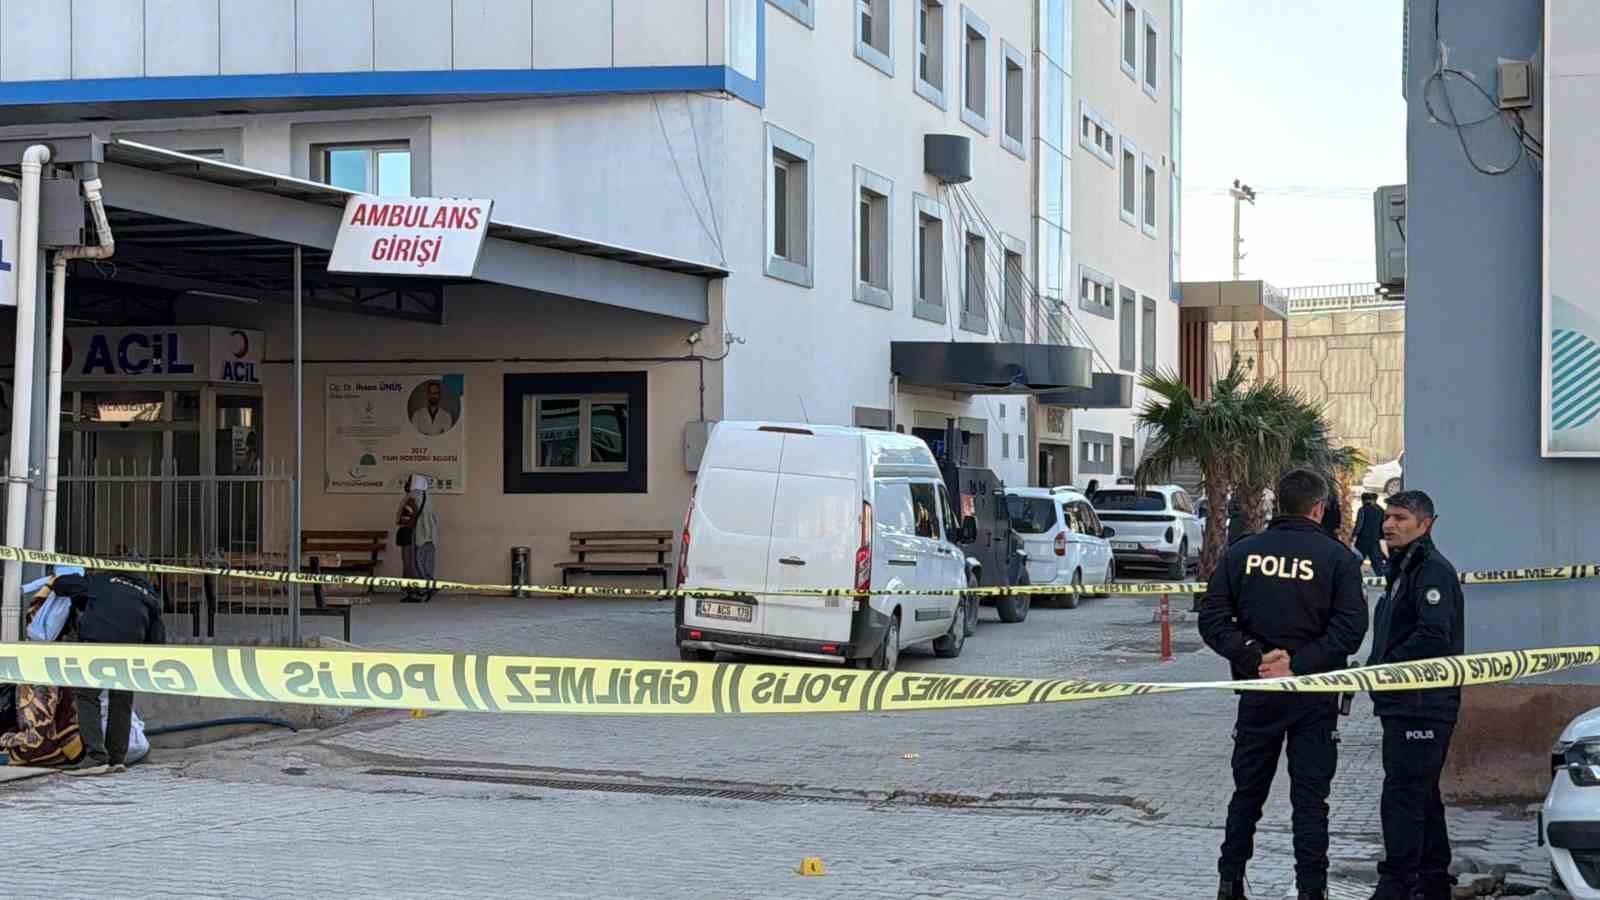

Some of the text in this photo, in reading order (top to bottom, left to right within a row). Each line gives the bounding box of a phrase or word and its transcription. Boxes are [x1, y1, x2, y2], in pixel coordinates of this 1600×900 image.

[350, 203, 482, 230] AMBULANS
[371, 234, 443, 268] GİRİŞİ
[222, 361, 260, 383] ACİL
[1246, 554, 1315, 581] POLİS
